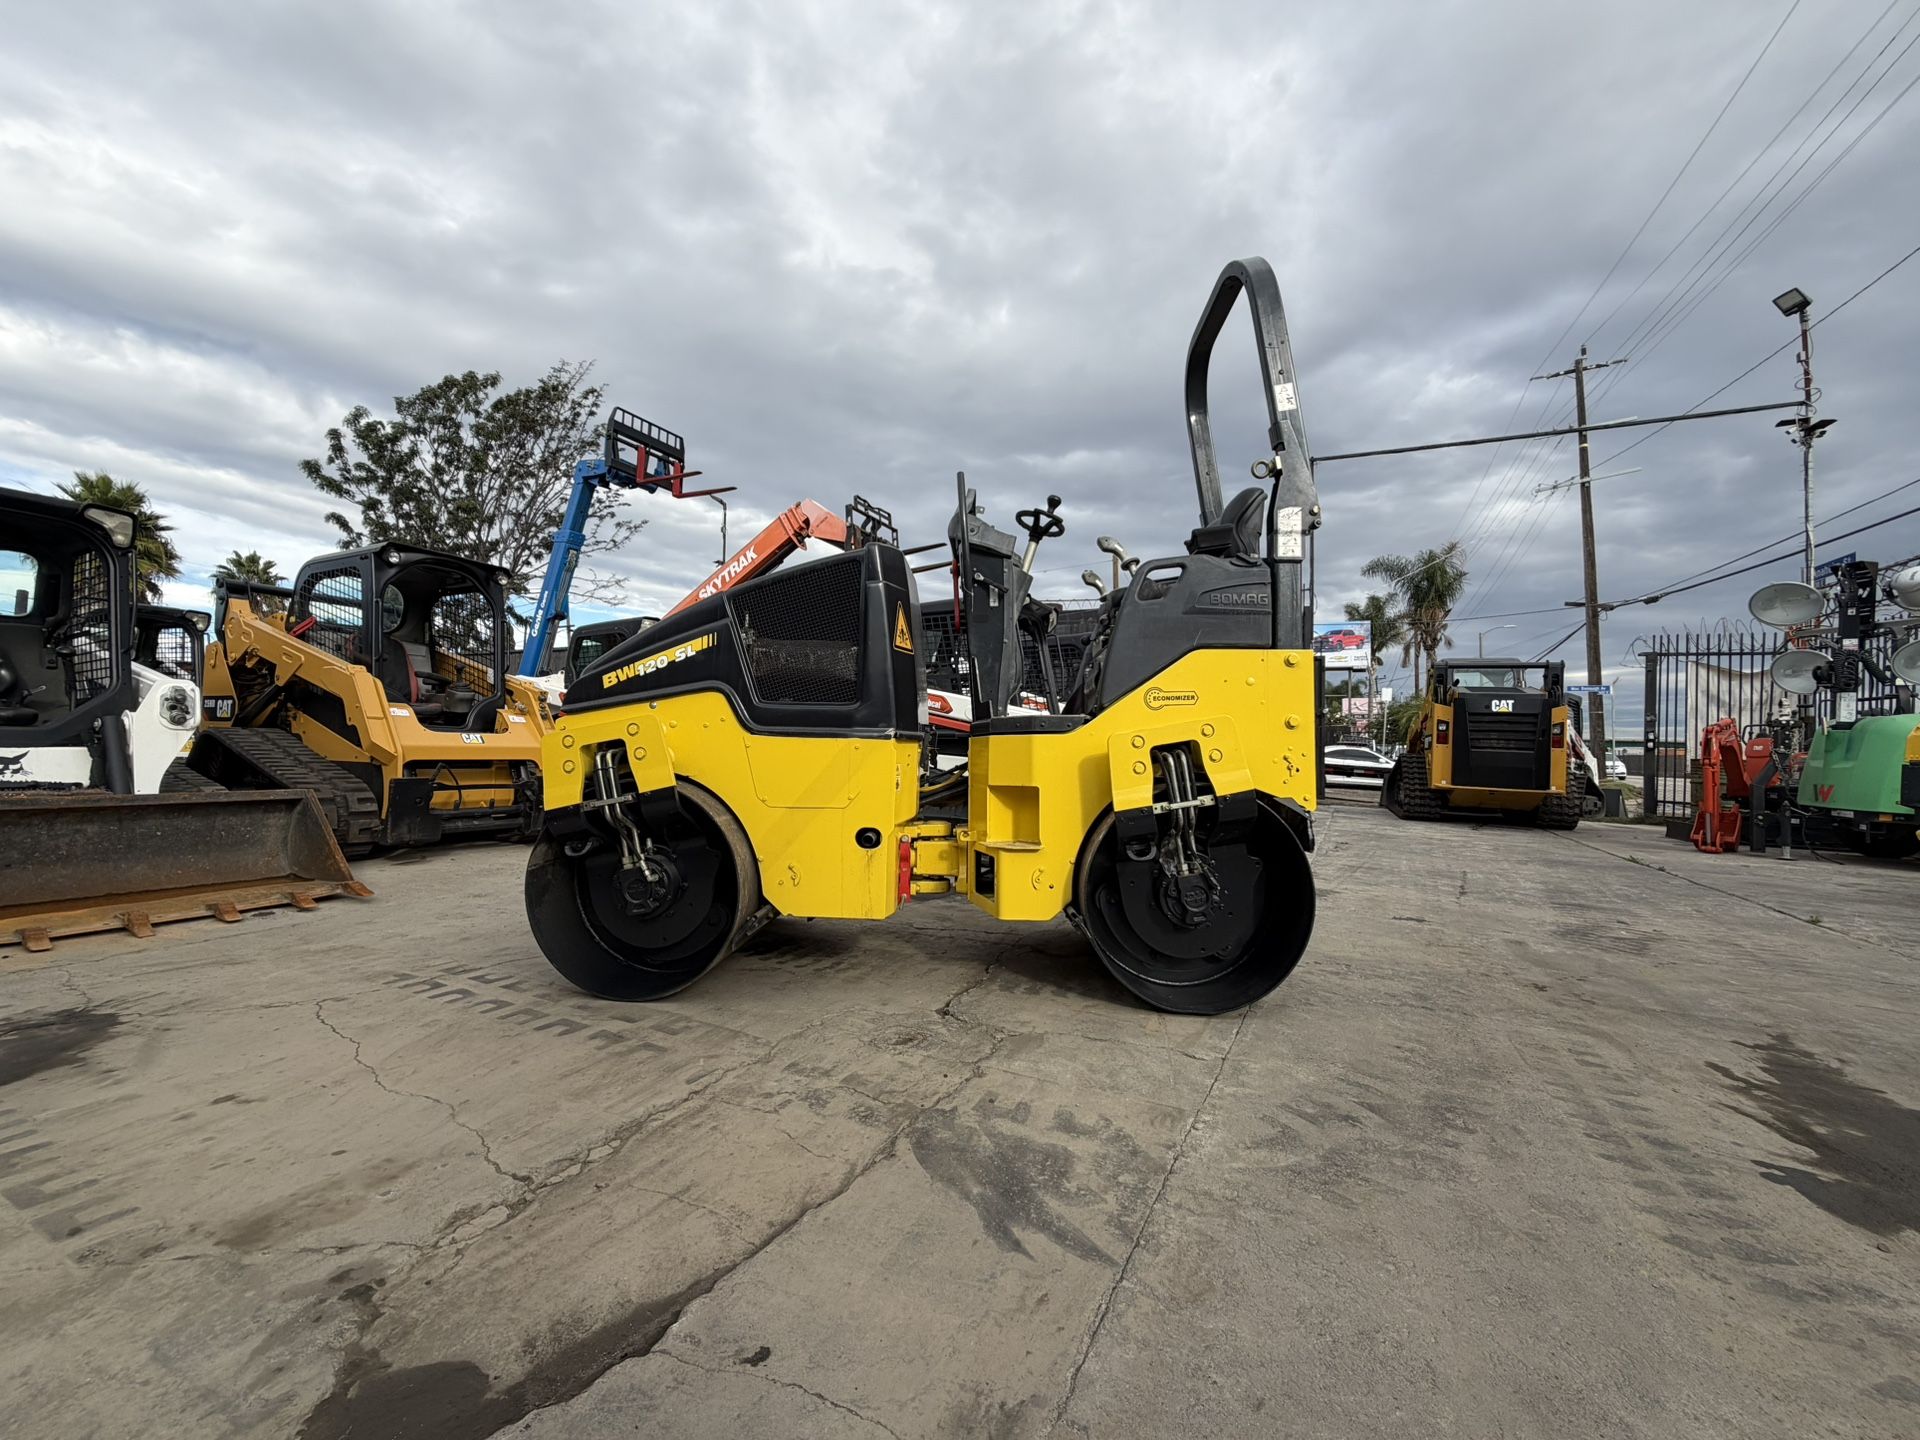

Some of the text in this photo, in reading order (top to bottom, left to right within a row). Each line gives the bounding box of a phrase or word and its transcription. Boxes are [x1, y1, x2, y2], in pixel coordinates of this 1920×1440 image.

[698, 545, 758, 598] SKYTRAK
[1210, 593, 1268, 605] BOMAG
[675, 645, 696, 662] SL
[1152, 694, 1196, 702] ECONOMIZER
[217, 699, 233, 717] CAT
[1491, 699, 1515, 712] CAT
[461, 734, 484, 744] CAT
